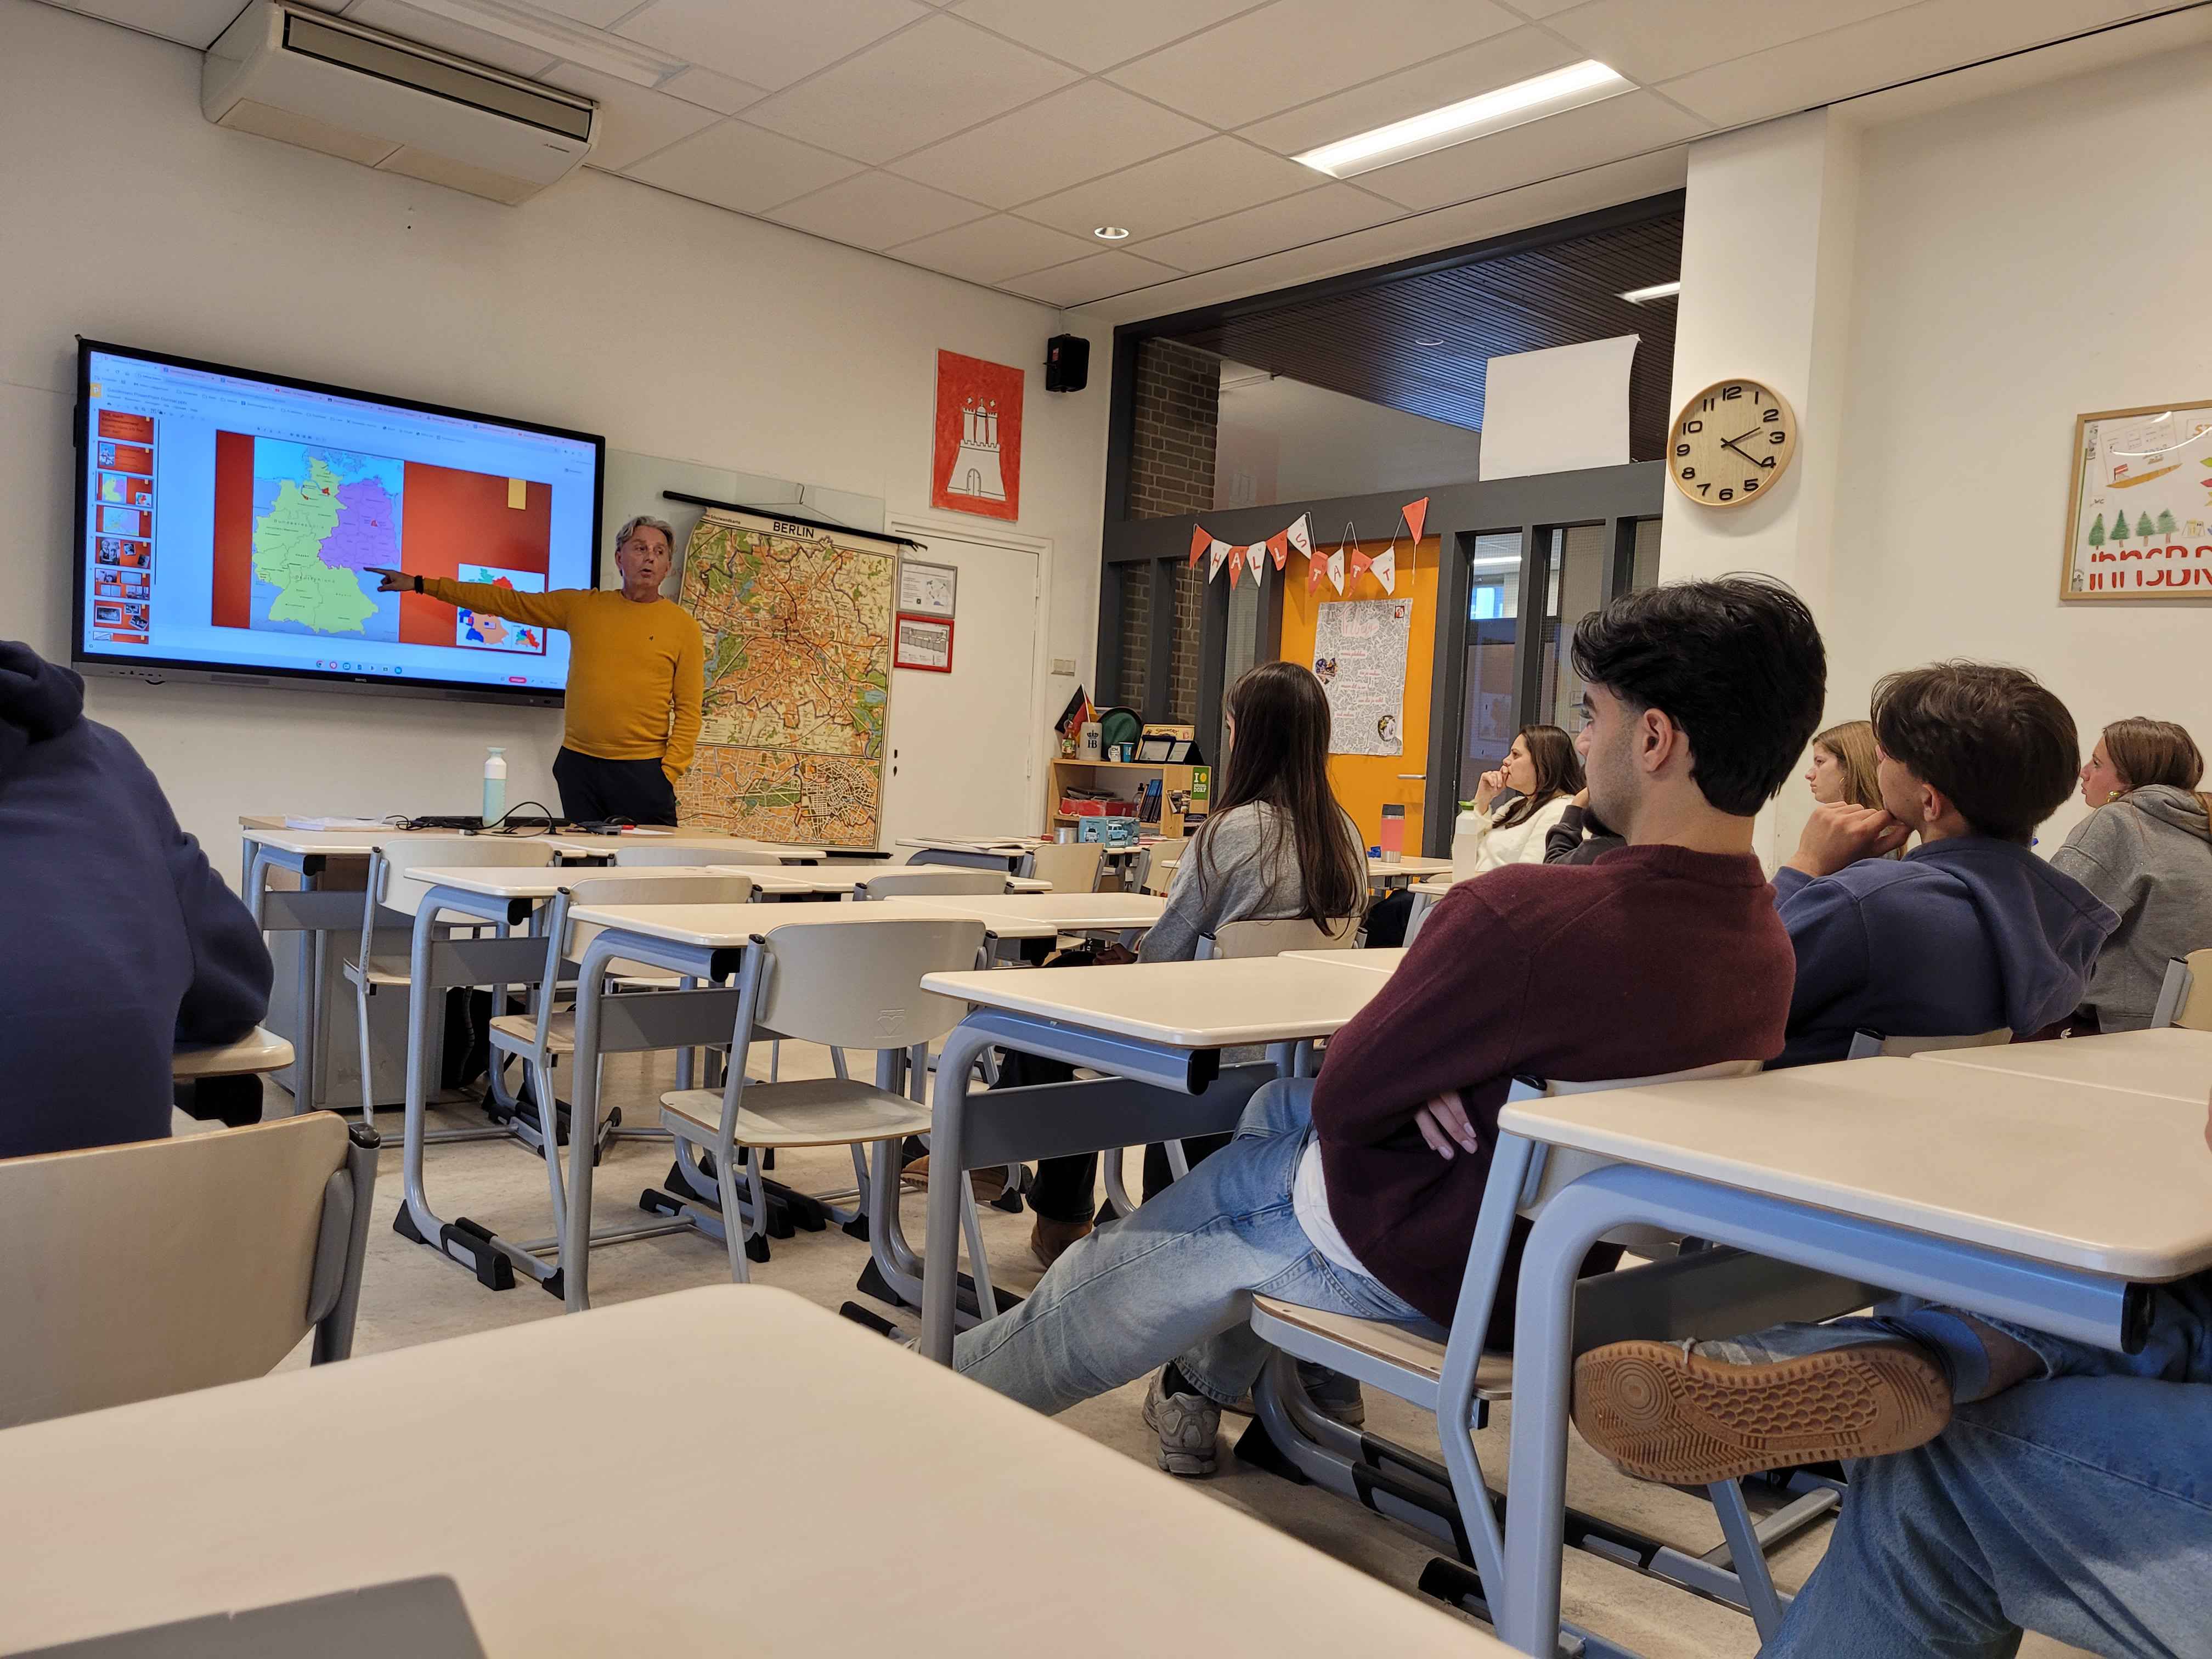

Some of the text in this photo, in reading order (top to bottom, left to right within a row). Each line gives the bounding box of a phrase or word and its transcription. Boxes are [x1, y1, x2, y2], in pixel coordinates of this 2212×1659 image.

[1723, 386, 1742, 401] 12
[1754, 391, 1759, 404] 1
[1703, 398, 1714, 411] 11
[1763, 409, 1779, 422] 2
[1683, 421, 1702, 435] 10
[1769, 431, 1785, 444] 3
[1677, 444, 1690, 456] 9
[1761, 456, 1776, 468] 4
[1681, 467, 1695, 479] 8
[1697, 483, 1711, 496] 7
[1743, 478, 1759, 492] 5
[1719, 488, 1733, 500] 6
[774, 521, 814, 538] BERLIN
